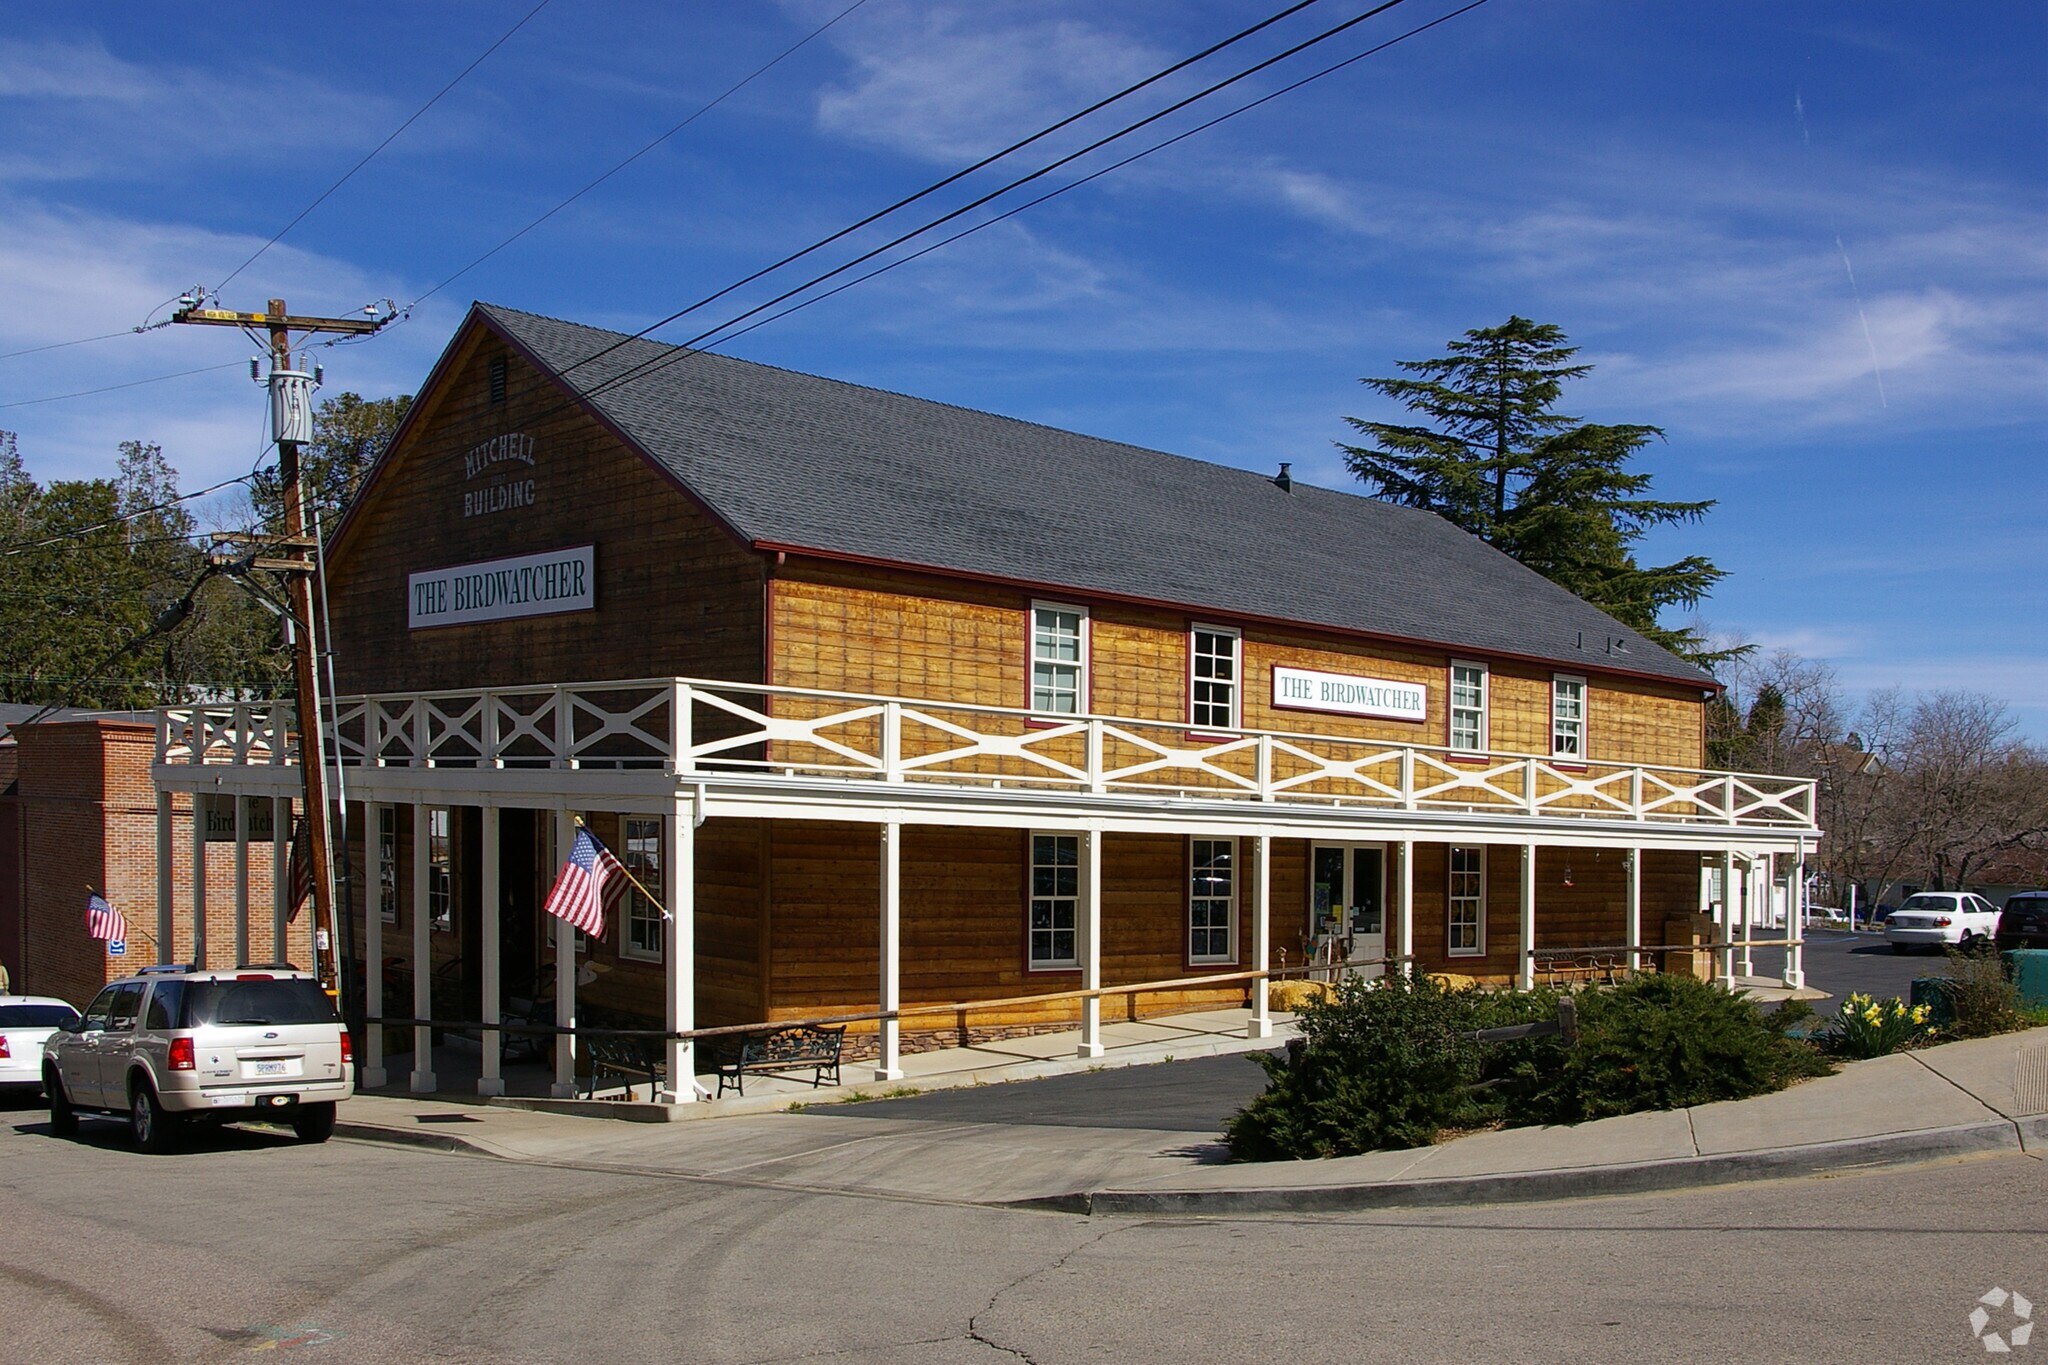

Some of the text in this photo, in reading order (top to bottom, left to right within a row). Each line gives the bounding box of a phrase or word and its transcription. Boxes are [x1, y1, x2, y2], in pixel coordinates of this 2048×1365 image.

[465, 433, 535, 479] MITCHELL
[465, 480, 535, 517] BUILDING
[415, 559, 586, 616] THE BIRDWATCHER
[1281, 676, 1421, 711] THE BIRDWATCHER
